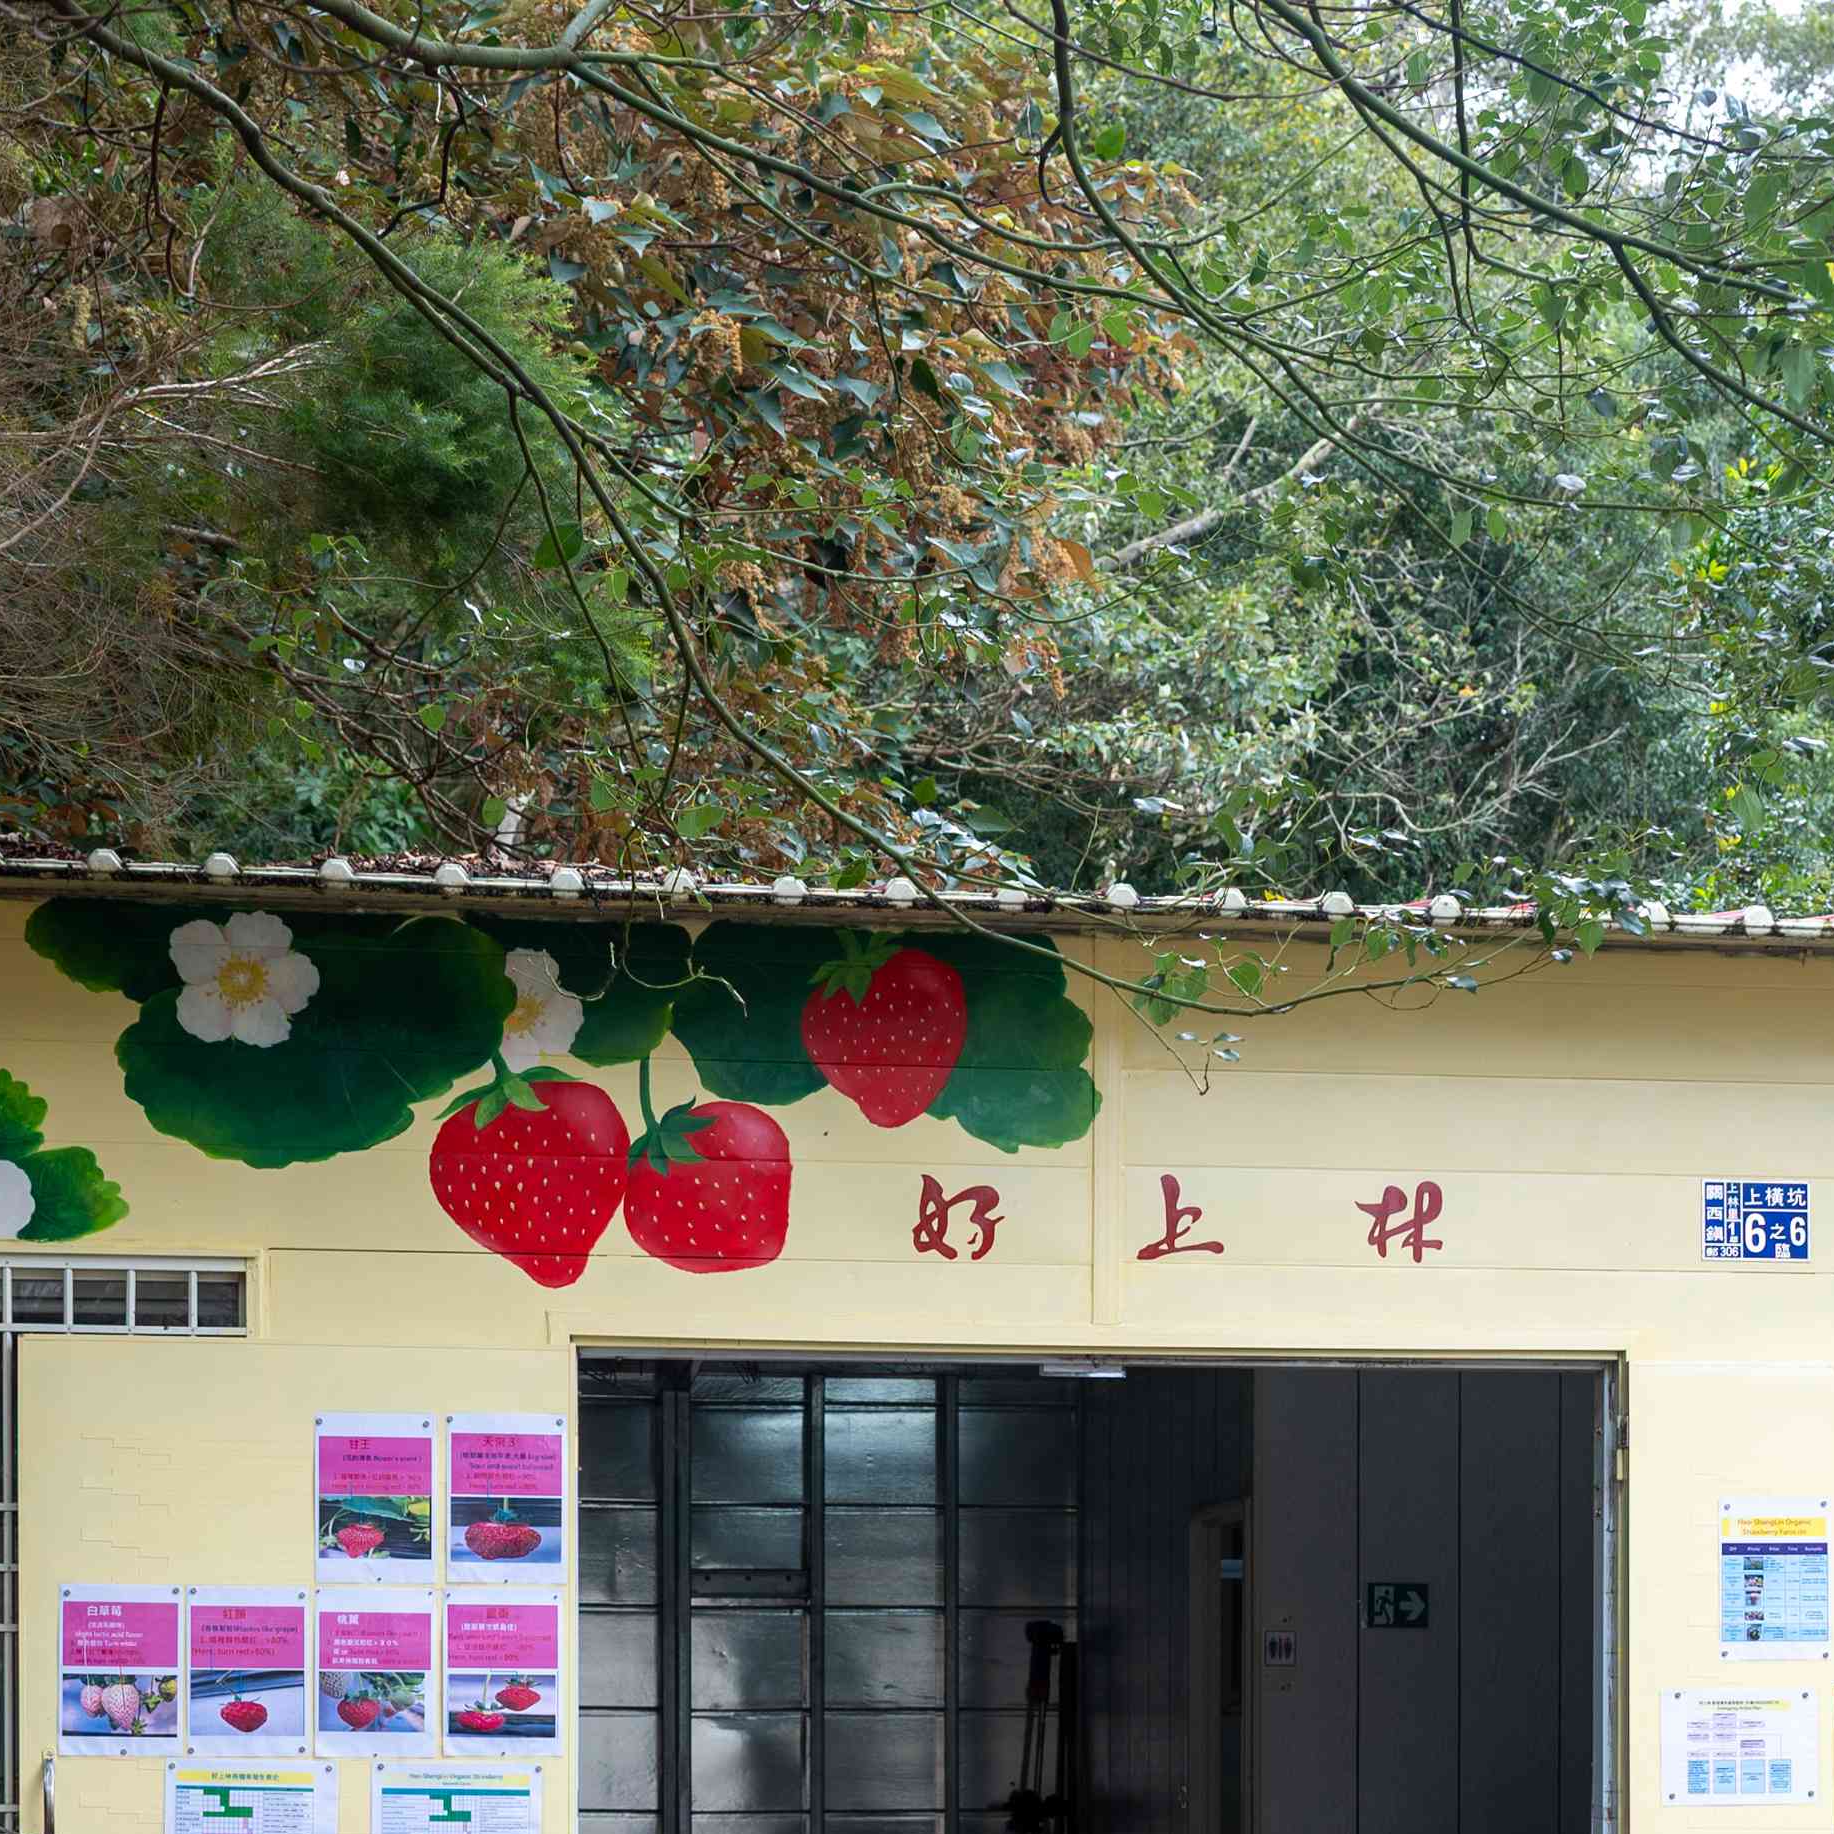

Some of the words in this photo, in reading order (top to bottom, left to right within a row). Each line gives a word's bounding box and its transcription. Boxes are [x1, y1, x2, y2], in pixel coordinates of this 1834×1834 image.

[1744, 1187, 1806, 1207] 上橫坑
[1744, 1212, 1807, 1253] 6之6
[87, 1606, 121, 1616] 白草莓
